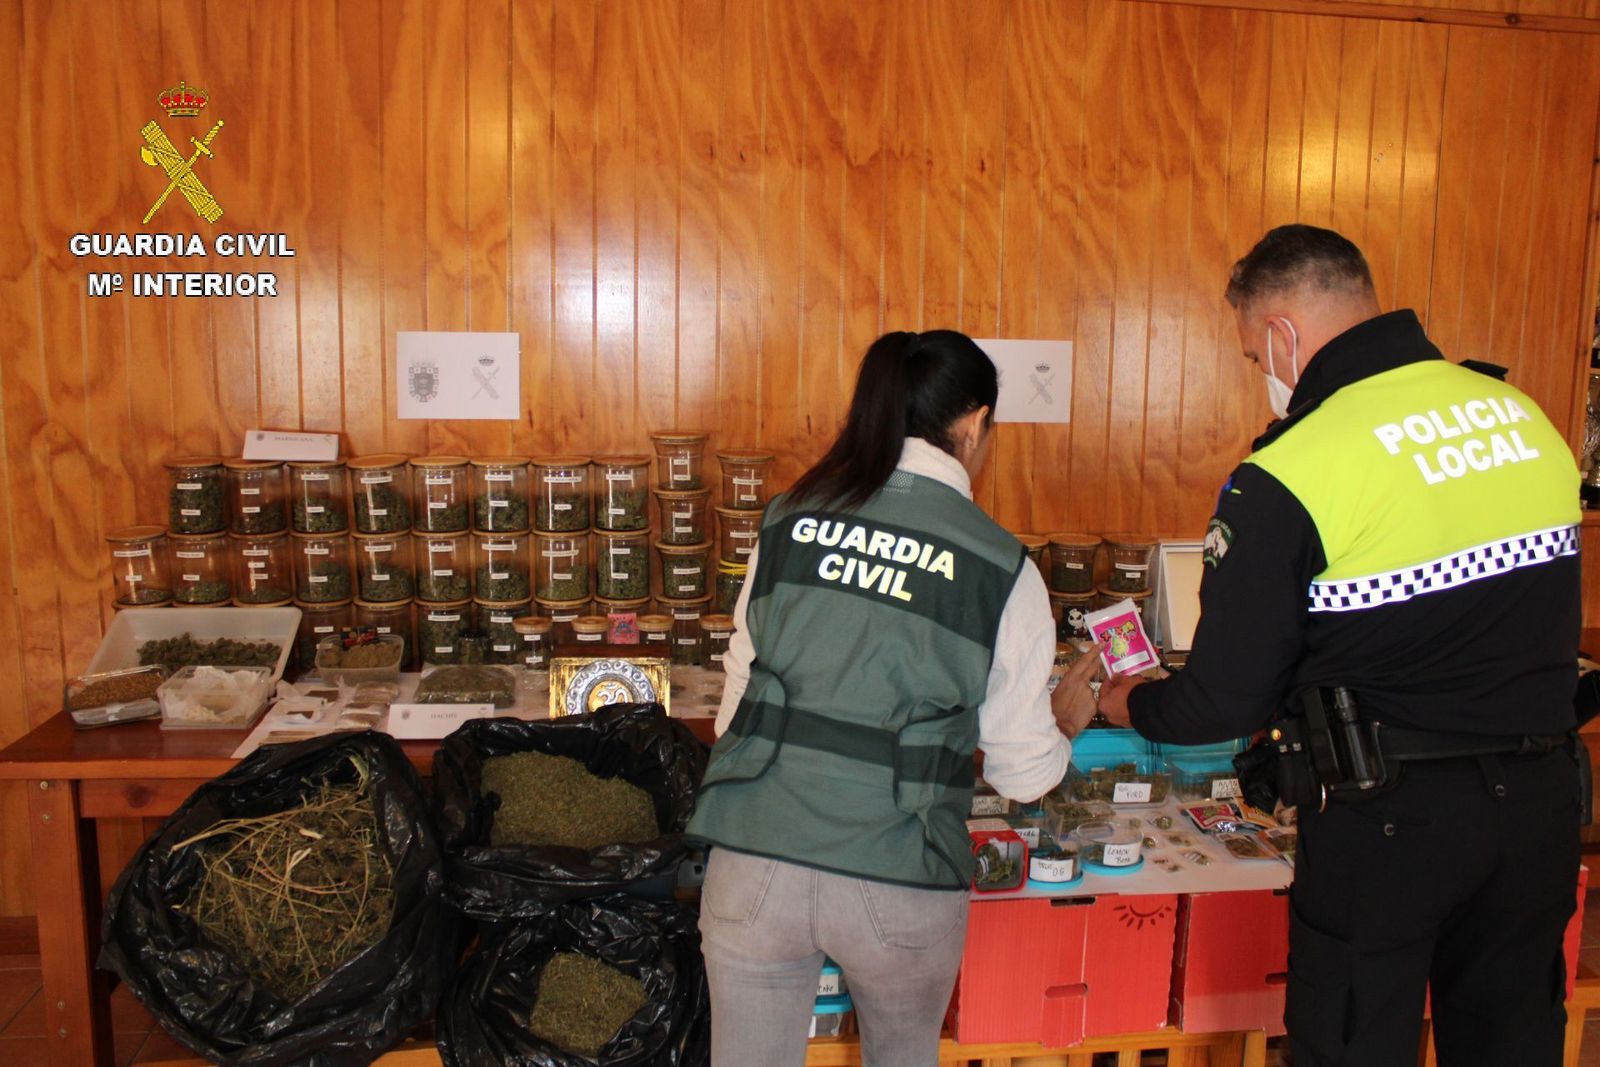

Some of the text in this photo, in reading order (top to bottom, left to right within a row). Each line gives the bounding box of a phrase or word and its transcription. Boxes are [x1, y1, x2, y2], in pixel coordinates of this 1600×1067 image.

[1373, 397, 1531, 456] POLICIA
[1413, 430, 1540, 485] LOCAL
[791, 517, 954, 581] GUARDIA
[818, 553, 912, 602] CIVIL
